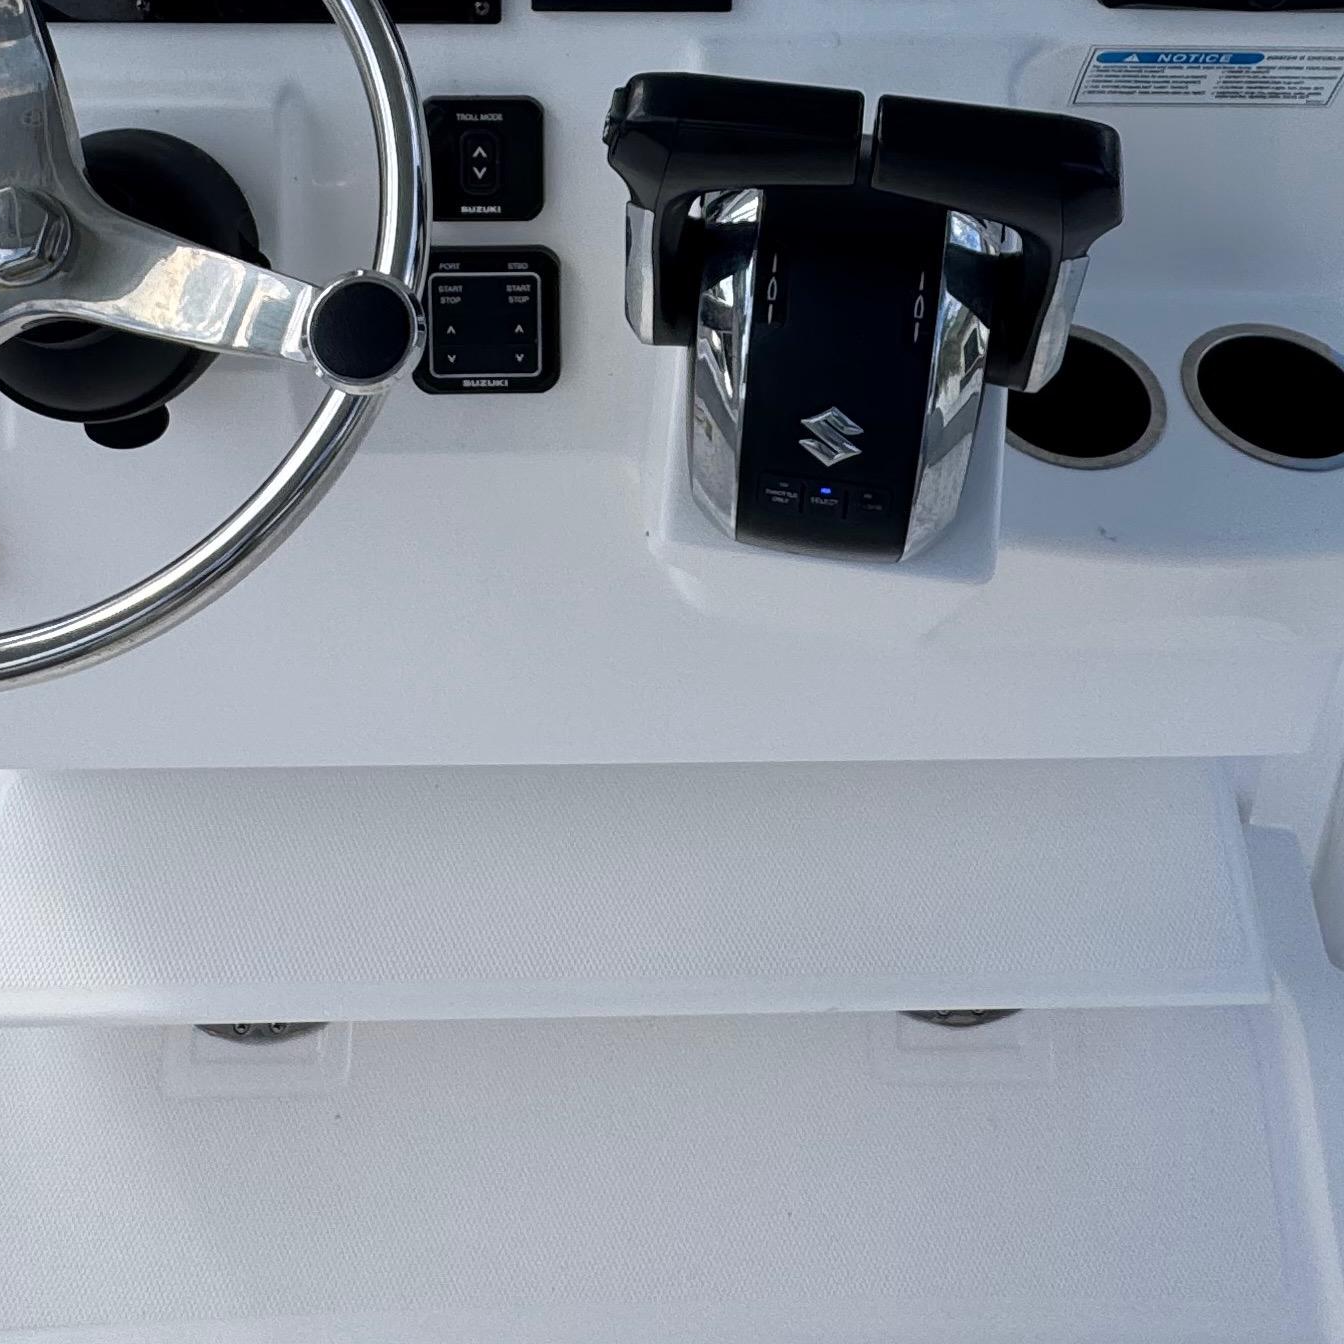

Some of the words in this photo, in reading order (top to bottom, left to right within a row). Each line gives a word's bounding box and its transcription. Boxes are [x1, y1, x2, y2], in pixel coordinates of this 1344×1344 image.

[1157, 53, 1233, 64] NOTICE
[456, 112, 479, 122] TROLL
[479, 113, 504, 122] MODE
[460, 205, 502, 214] SUZUKI
[438, 262, 462, 271] PORT
[438, 284, 463, 293] START
[505, 284, 532, 293] START
[440, 296, 462, 304] STOP
[508, 296, 530, 304] STOP
[461, 378, 509, 388] SUZUKI
